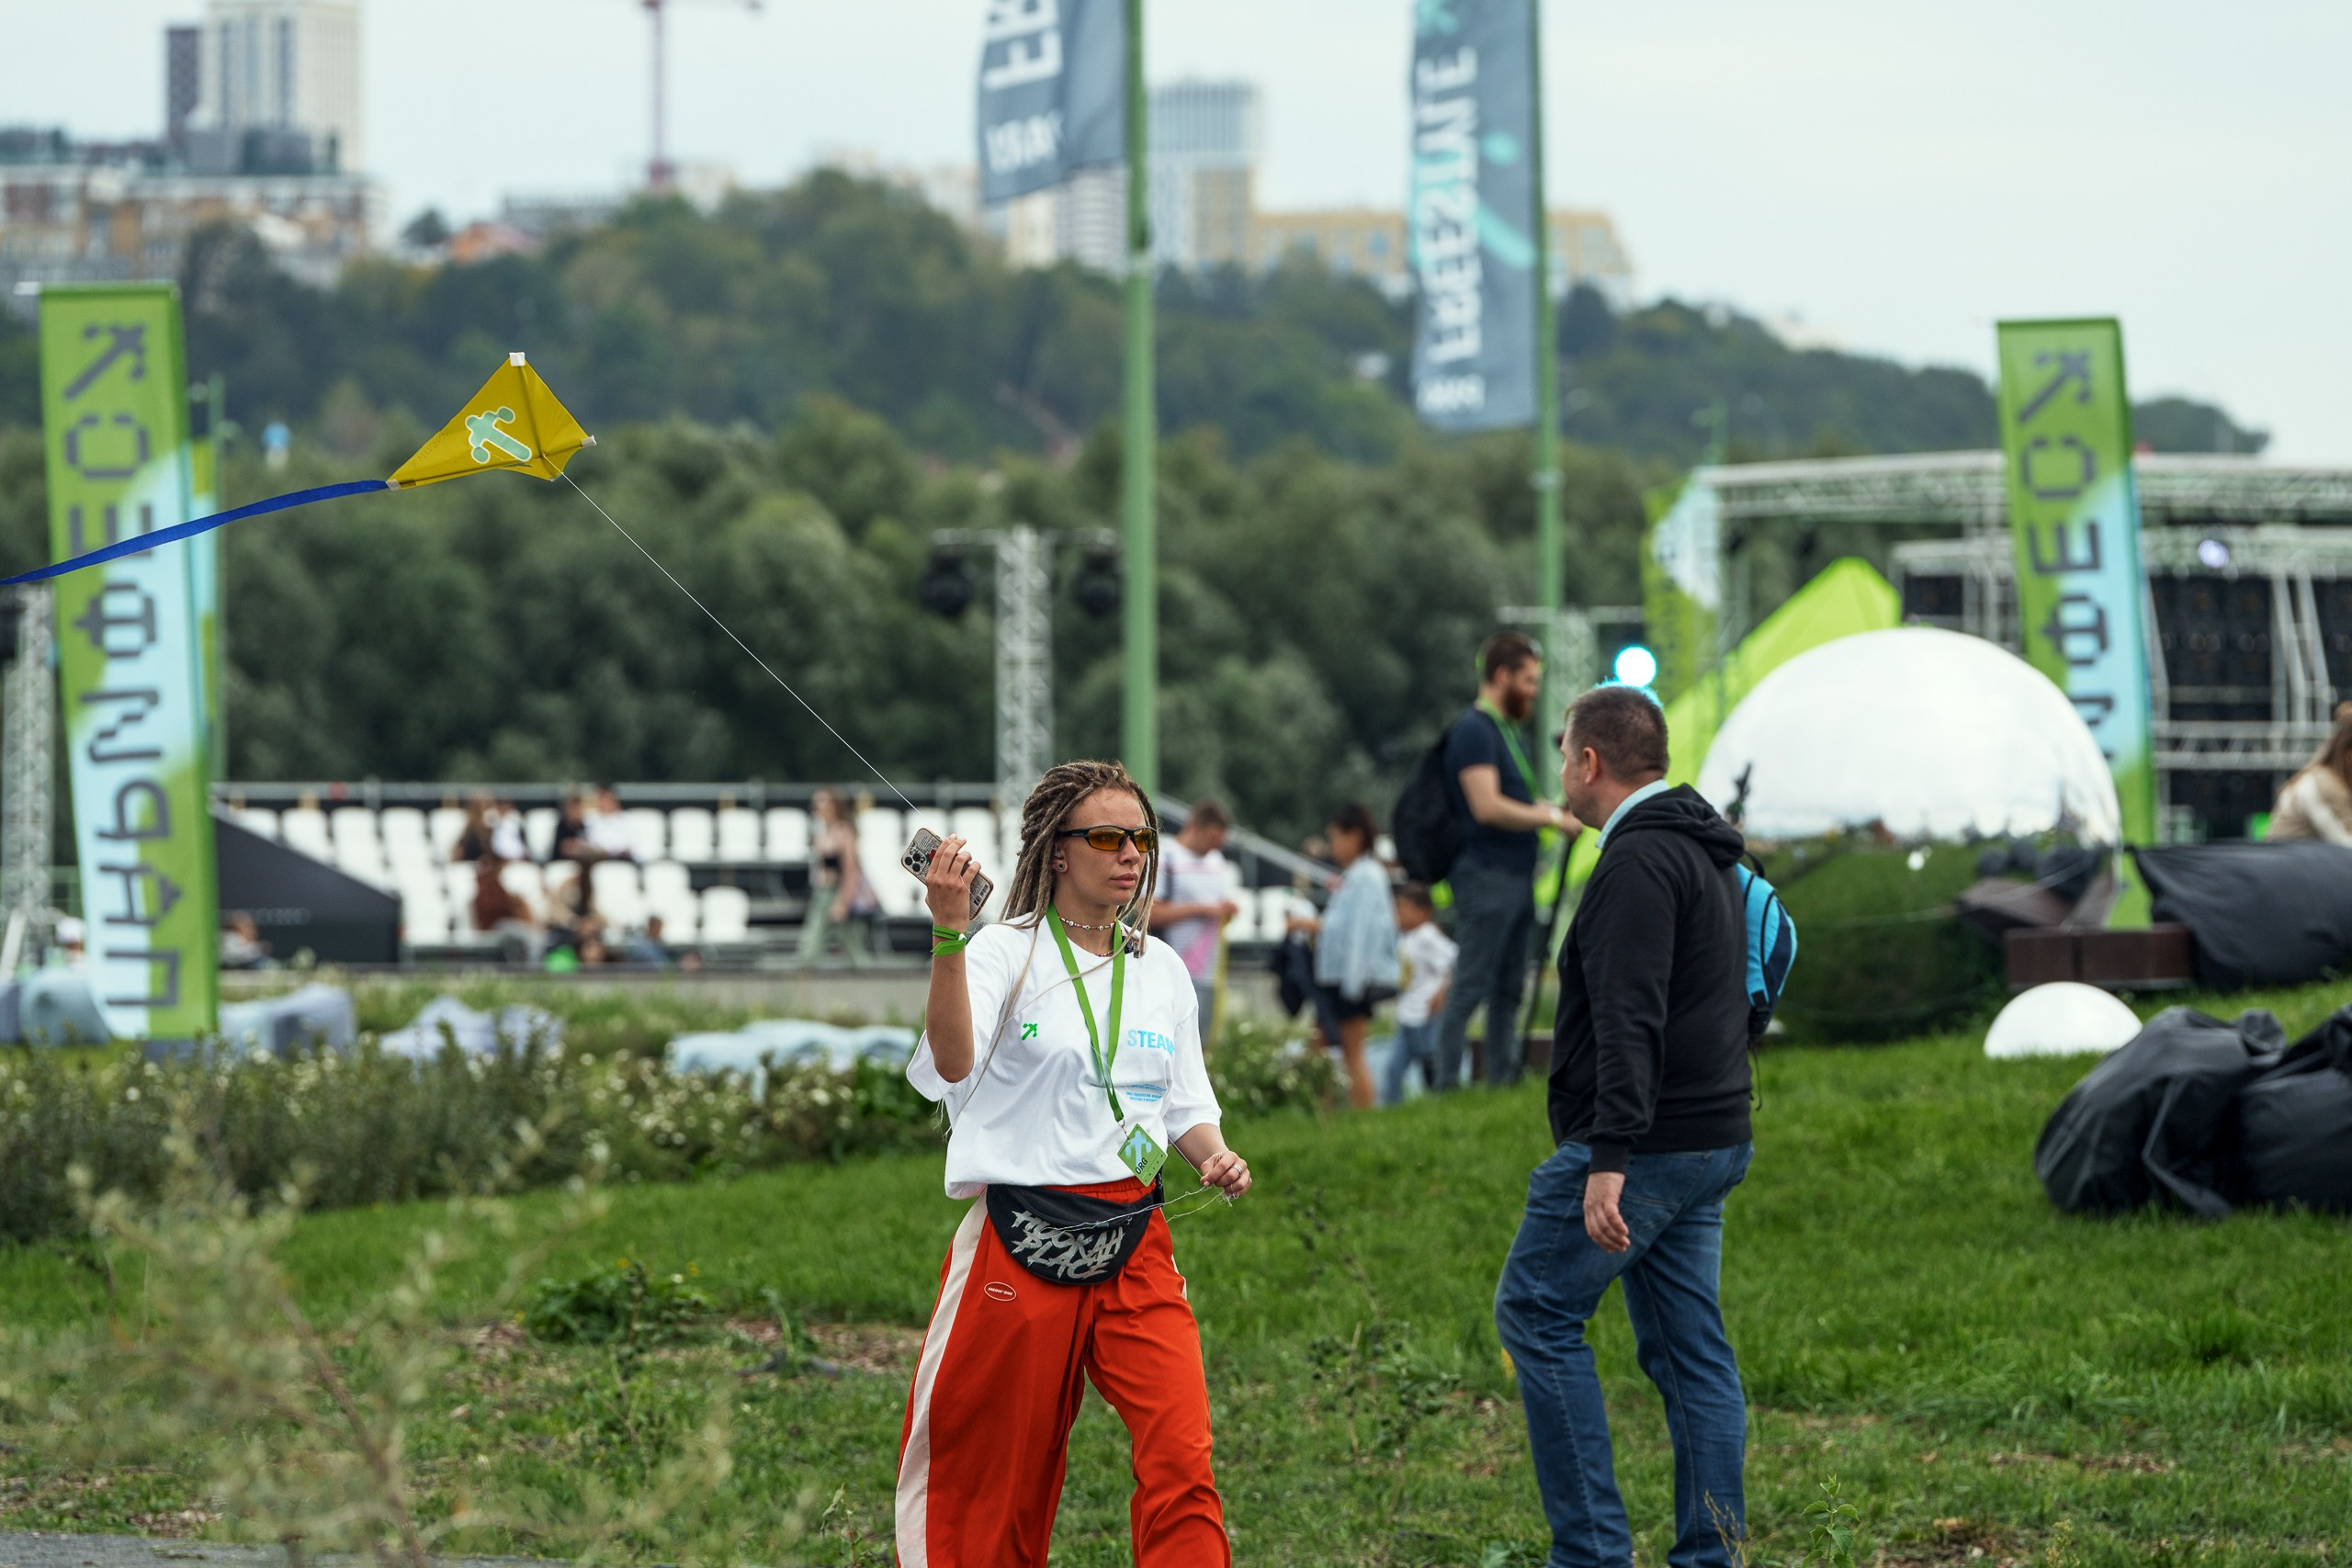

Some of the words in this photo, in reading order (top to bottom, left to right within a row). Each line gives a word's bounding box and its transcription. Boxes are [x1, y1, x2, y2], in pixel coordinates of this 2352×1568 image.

[1135, 1156, 1148, 1175] ORG
[1012, 1211, 1125, 1266] HOOKAH
[1012, 1229, 1114, 1280] PLACE
